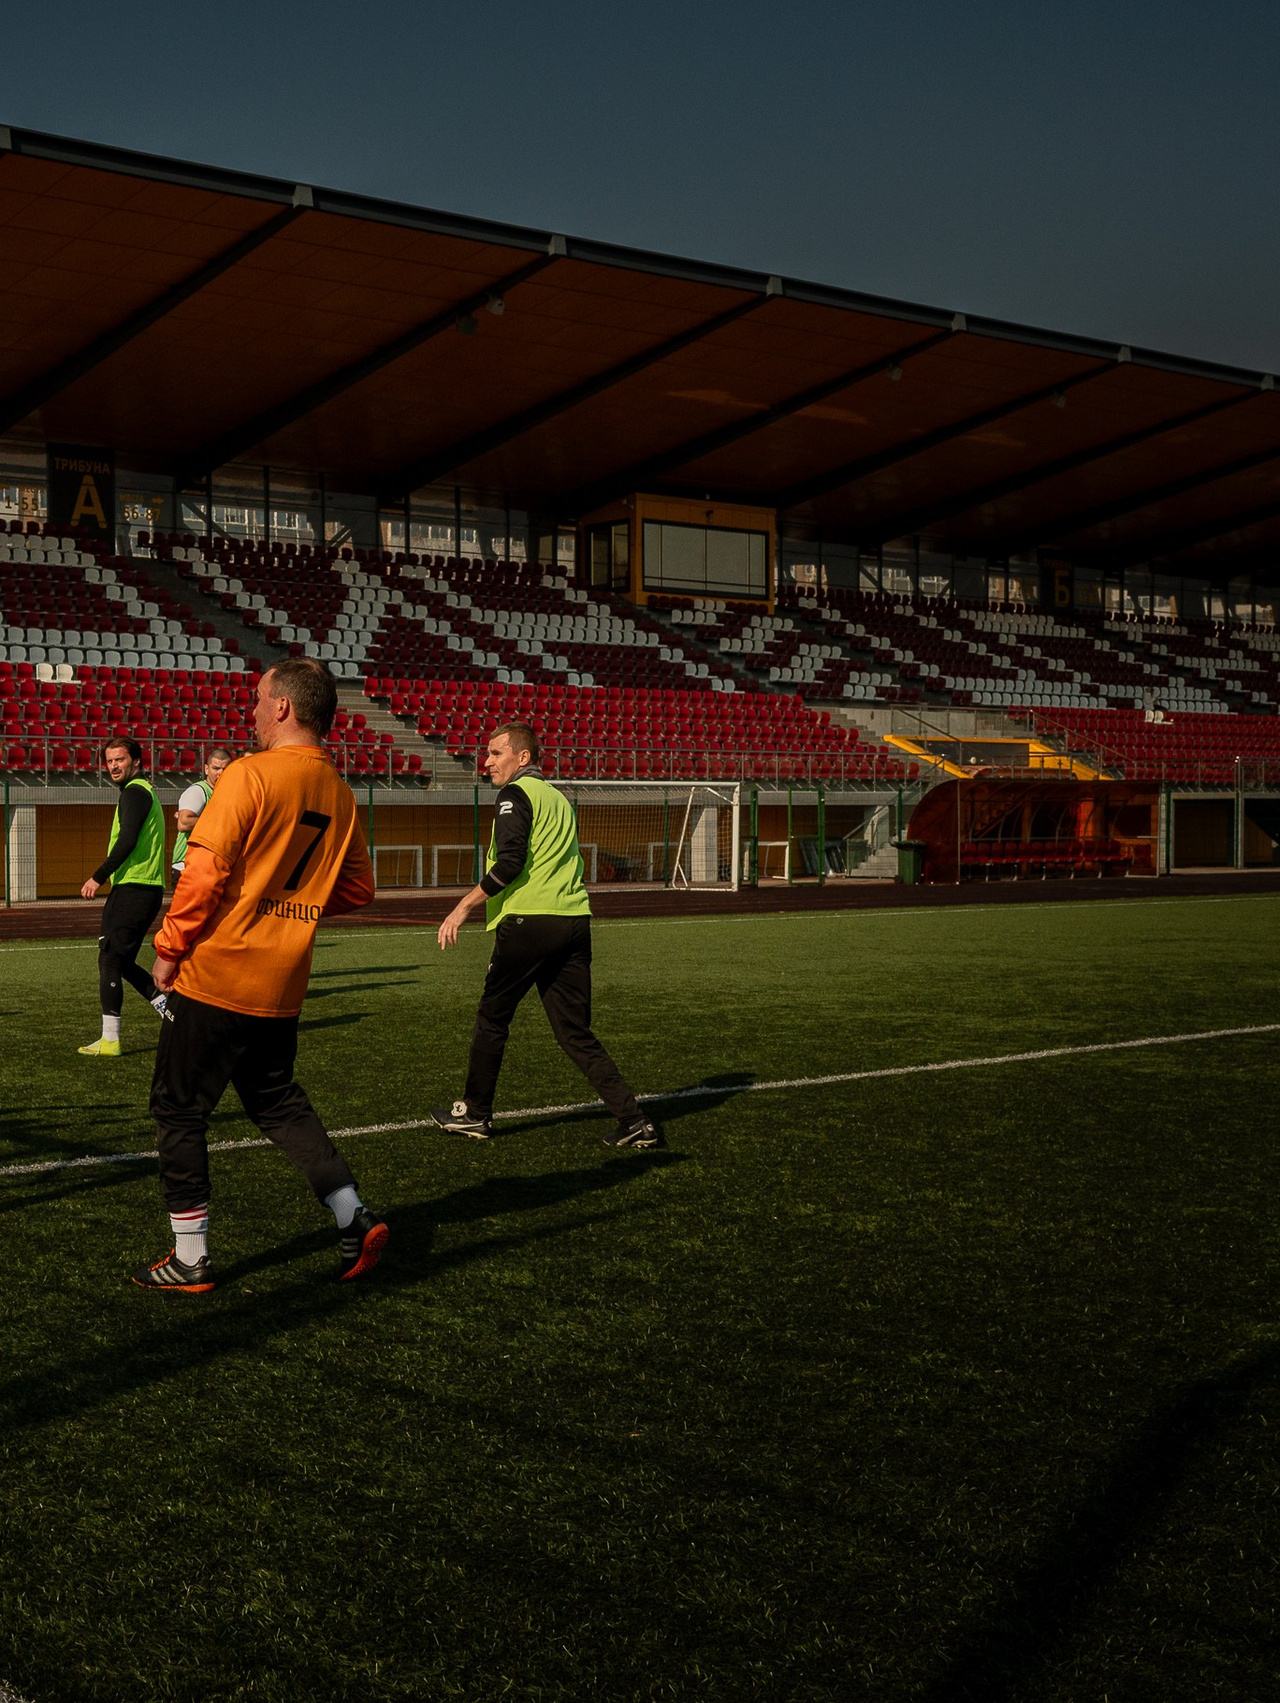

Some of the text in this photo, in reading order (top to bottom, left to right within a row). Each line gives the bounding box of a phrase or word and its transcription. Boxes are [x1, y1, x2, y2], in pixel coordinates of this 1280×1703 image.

[54, 456, 111, 475] ТРИБУНА
[5, 495, 39, 511] 1-55
[283, 810, 332, 891] 7
